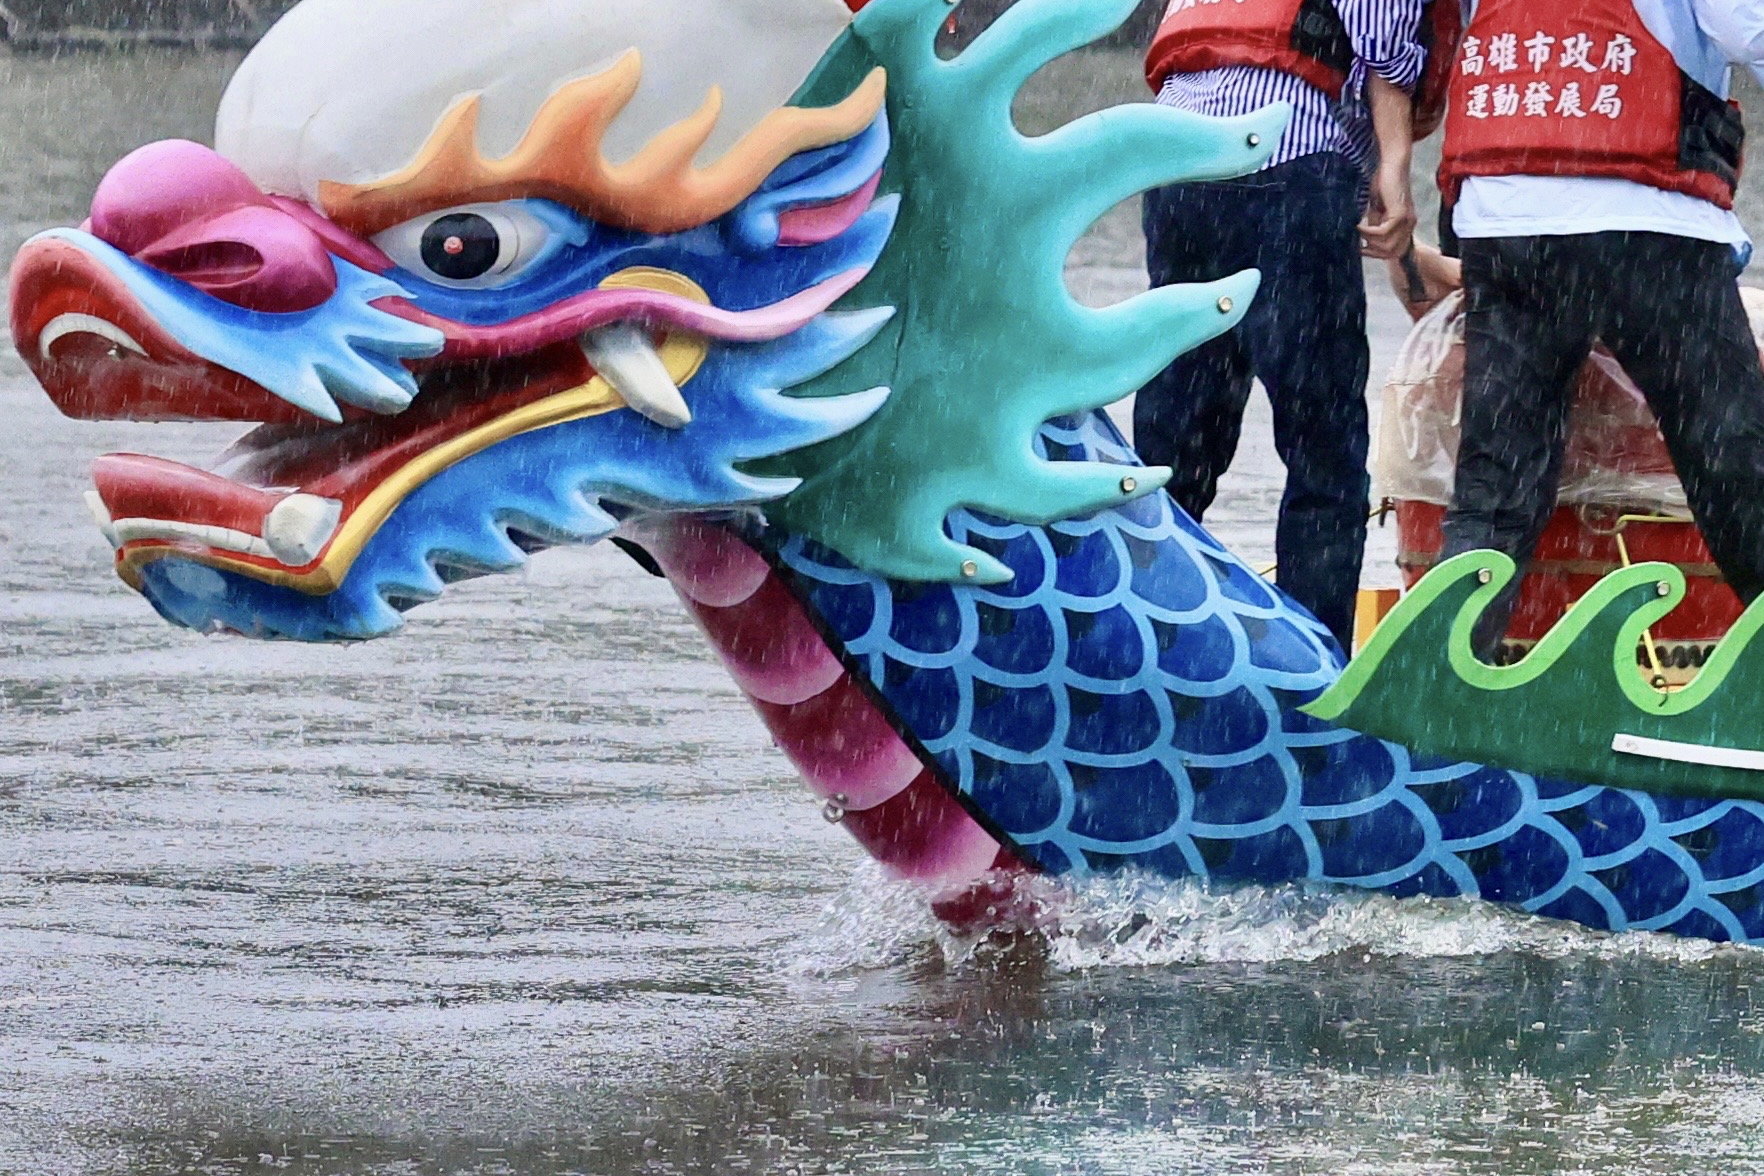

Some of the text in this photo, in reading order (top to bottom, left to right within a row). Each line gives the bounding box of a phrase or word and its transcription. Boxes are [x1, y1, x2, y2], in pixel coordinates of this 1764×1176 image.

[1461, 31, 1637, 75] 高雄市政府
[1466, 81, 1622, 119] 運動發展局
